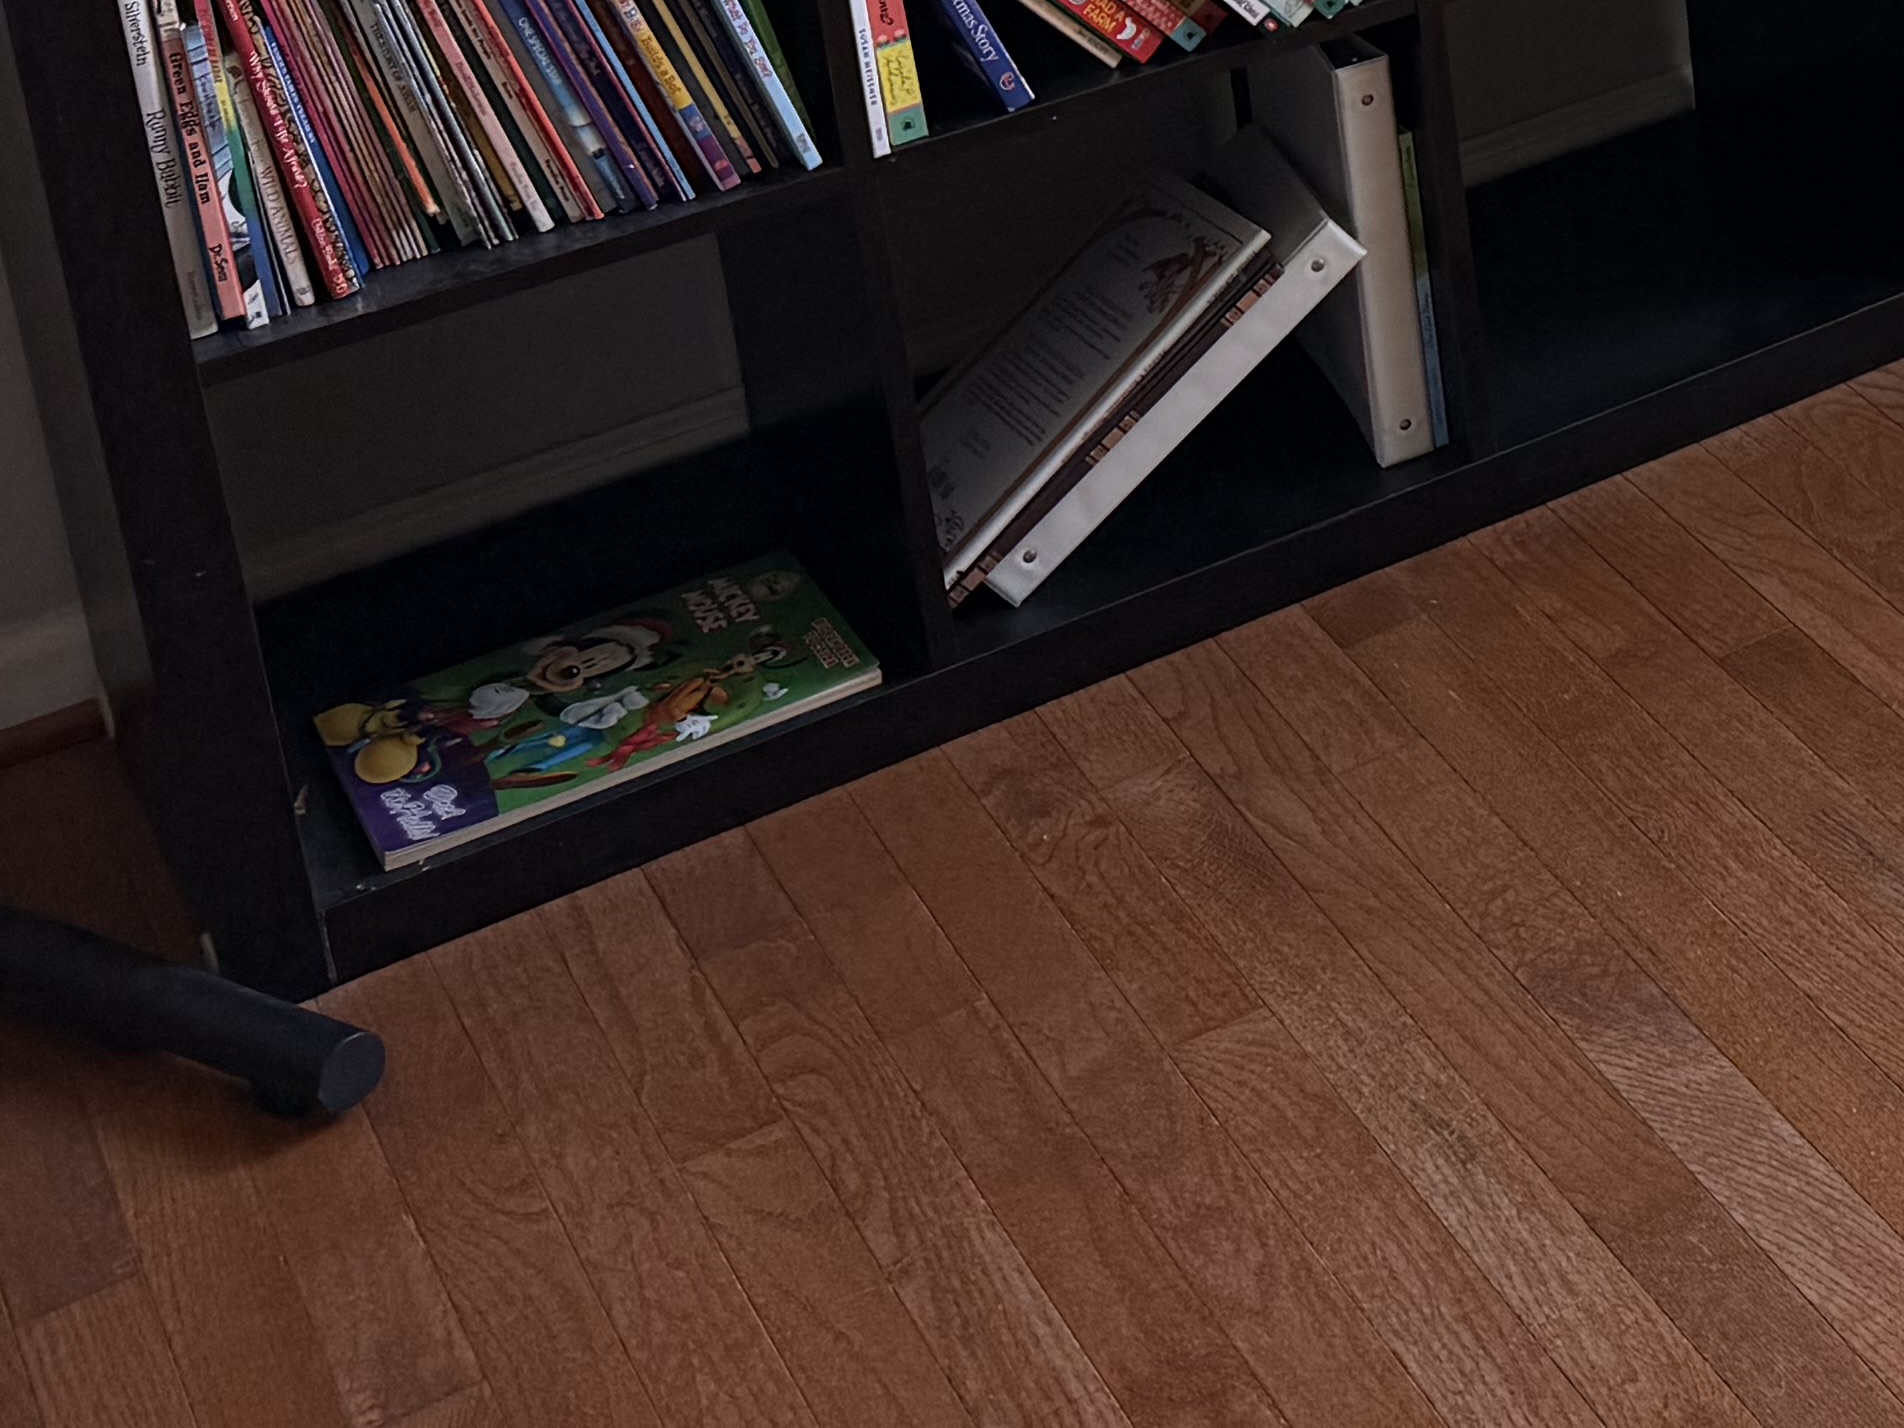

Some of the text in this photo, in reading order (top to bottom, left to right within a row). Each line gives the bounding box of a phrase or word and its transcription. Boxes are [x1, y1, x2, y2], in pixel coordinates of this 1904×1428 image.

[1081, 1, 1117, 34] FARM
[1113, 8, 1127, 24] A
[516, 15, 563, 87] ONE SPECIAL STAR
[857, 27, 870, 58] SUSAN
[964, 21, 1004, 68] Story
[122, 0, 184, 209] Silverstein Runny Babbit
[168, 51, 214, 205] Green Eggs and Ham
[241, 49, 266, 81] Why
[278, 144, 308, 191] Afraid?
[258, 165, 302, 266] WILD ANIMALS
[677, 587, 731, 635] MOUSE
[706, 573, 762, 625] MICKEY
